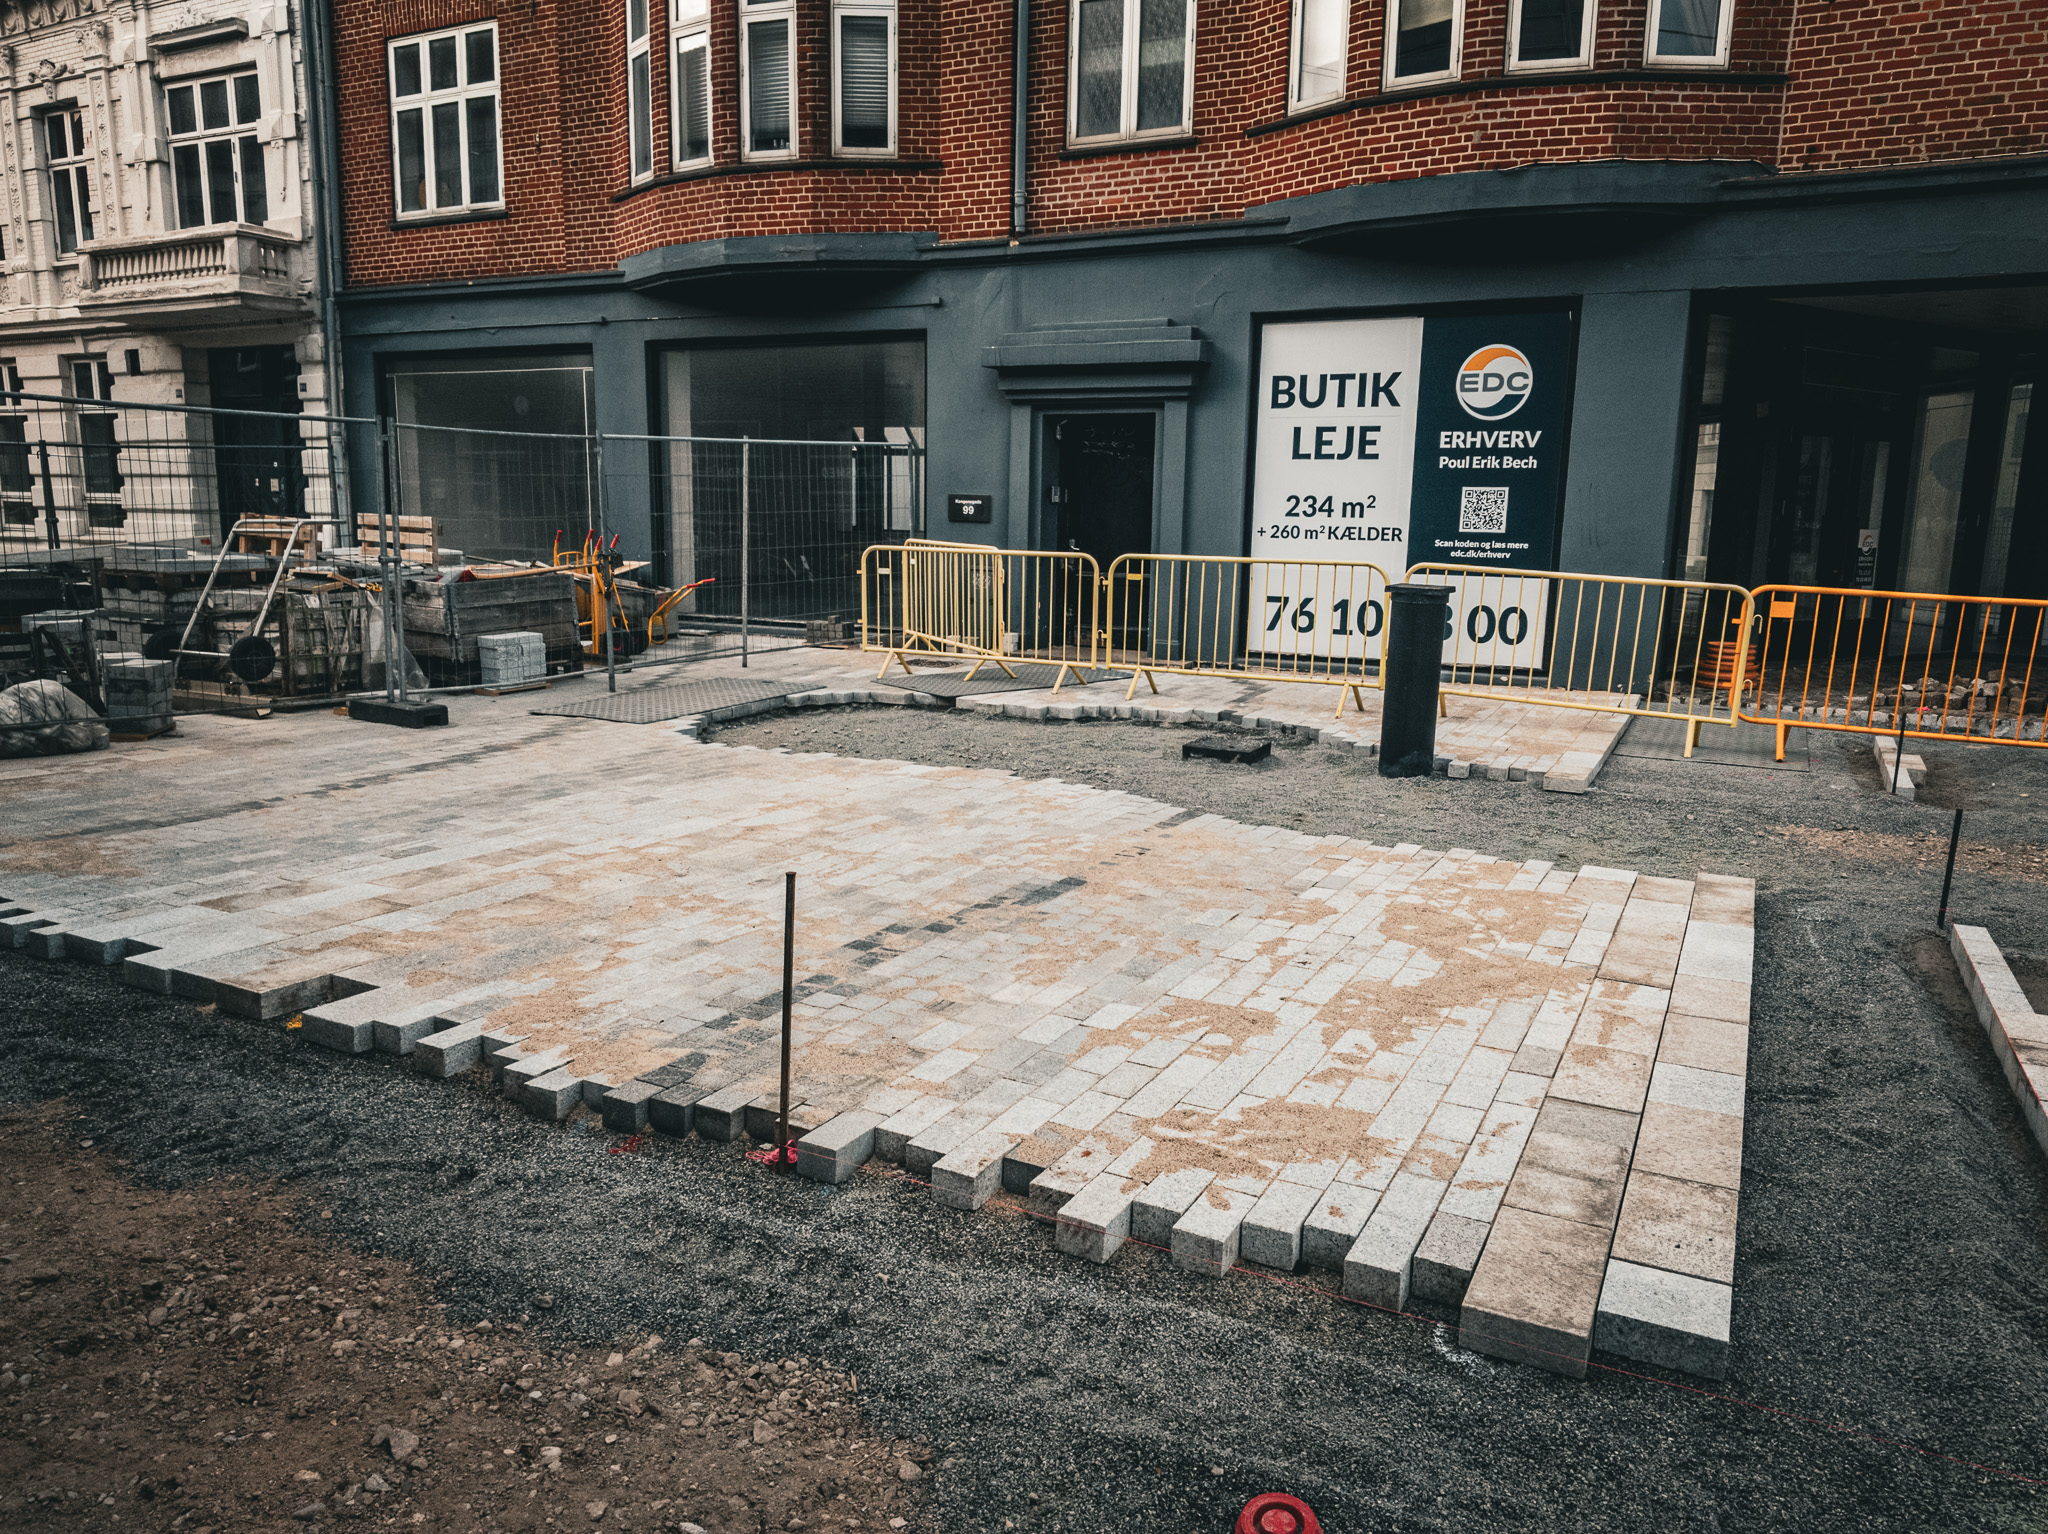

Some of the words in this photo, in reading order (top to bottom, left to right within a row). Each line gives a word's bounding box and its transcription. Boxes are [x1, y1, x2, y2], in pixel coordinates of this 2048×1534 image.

[1271, 371, 1402, 409] BUTIK
[1460, 371, 1530, 393] EDC
[1292, 425, 1381, 460] LEJE
[1439, 430, 1542, 449] ERHVERV
[1438, 455, 1470, 469] Poul
[1471, 455, 1501, 469] Erik
[1502, 455, 1538, 469] Bech
[962, 505, 974, 514] 99
[1285, 494, 1335, 518] 234
[1270, 524, 1301, 540] 260
[1327, 525, 1403, 542] KÆLDER
[1434, 539, 1454, 548] Scan
[1454, 539, 1480, 549] koden
[1480, 542, 1491, 550] og
[1491, 540, 1507, 549] læs
[1450, 549, 1512, 559] edc.dk/erhverv
[1265, 595, 1316, 634] 76
[1332, 598, 1384, 638] 10
[1466, 604, 1529, 646] 00
